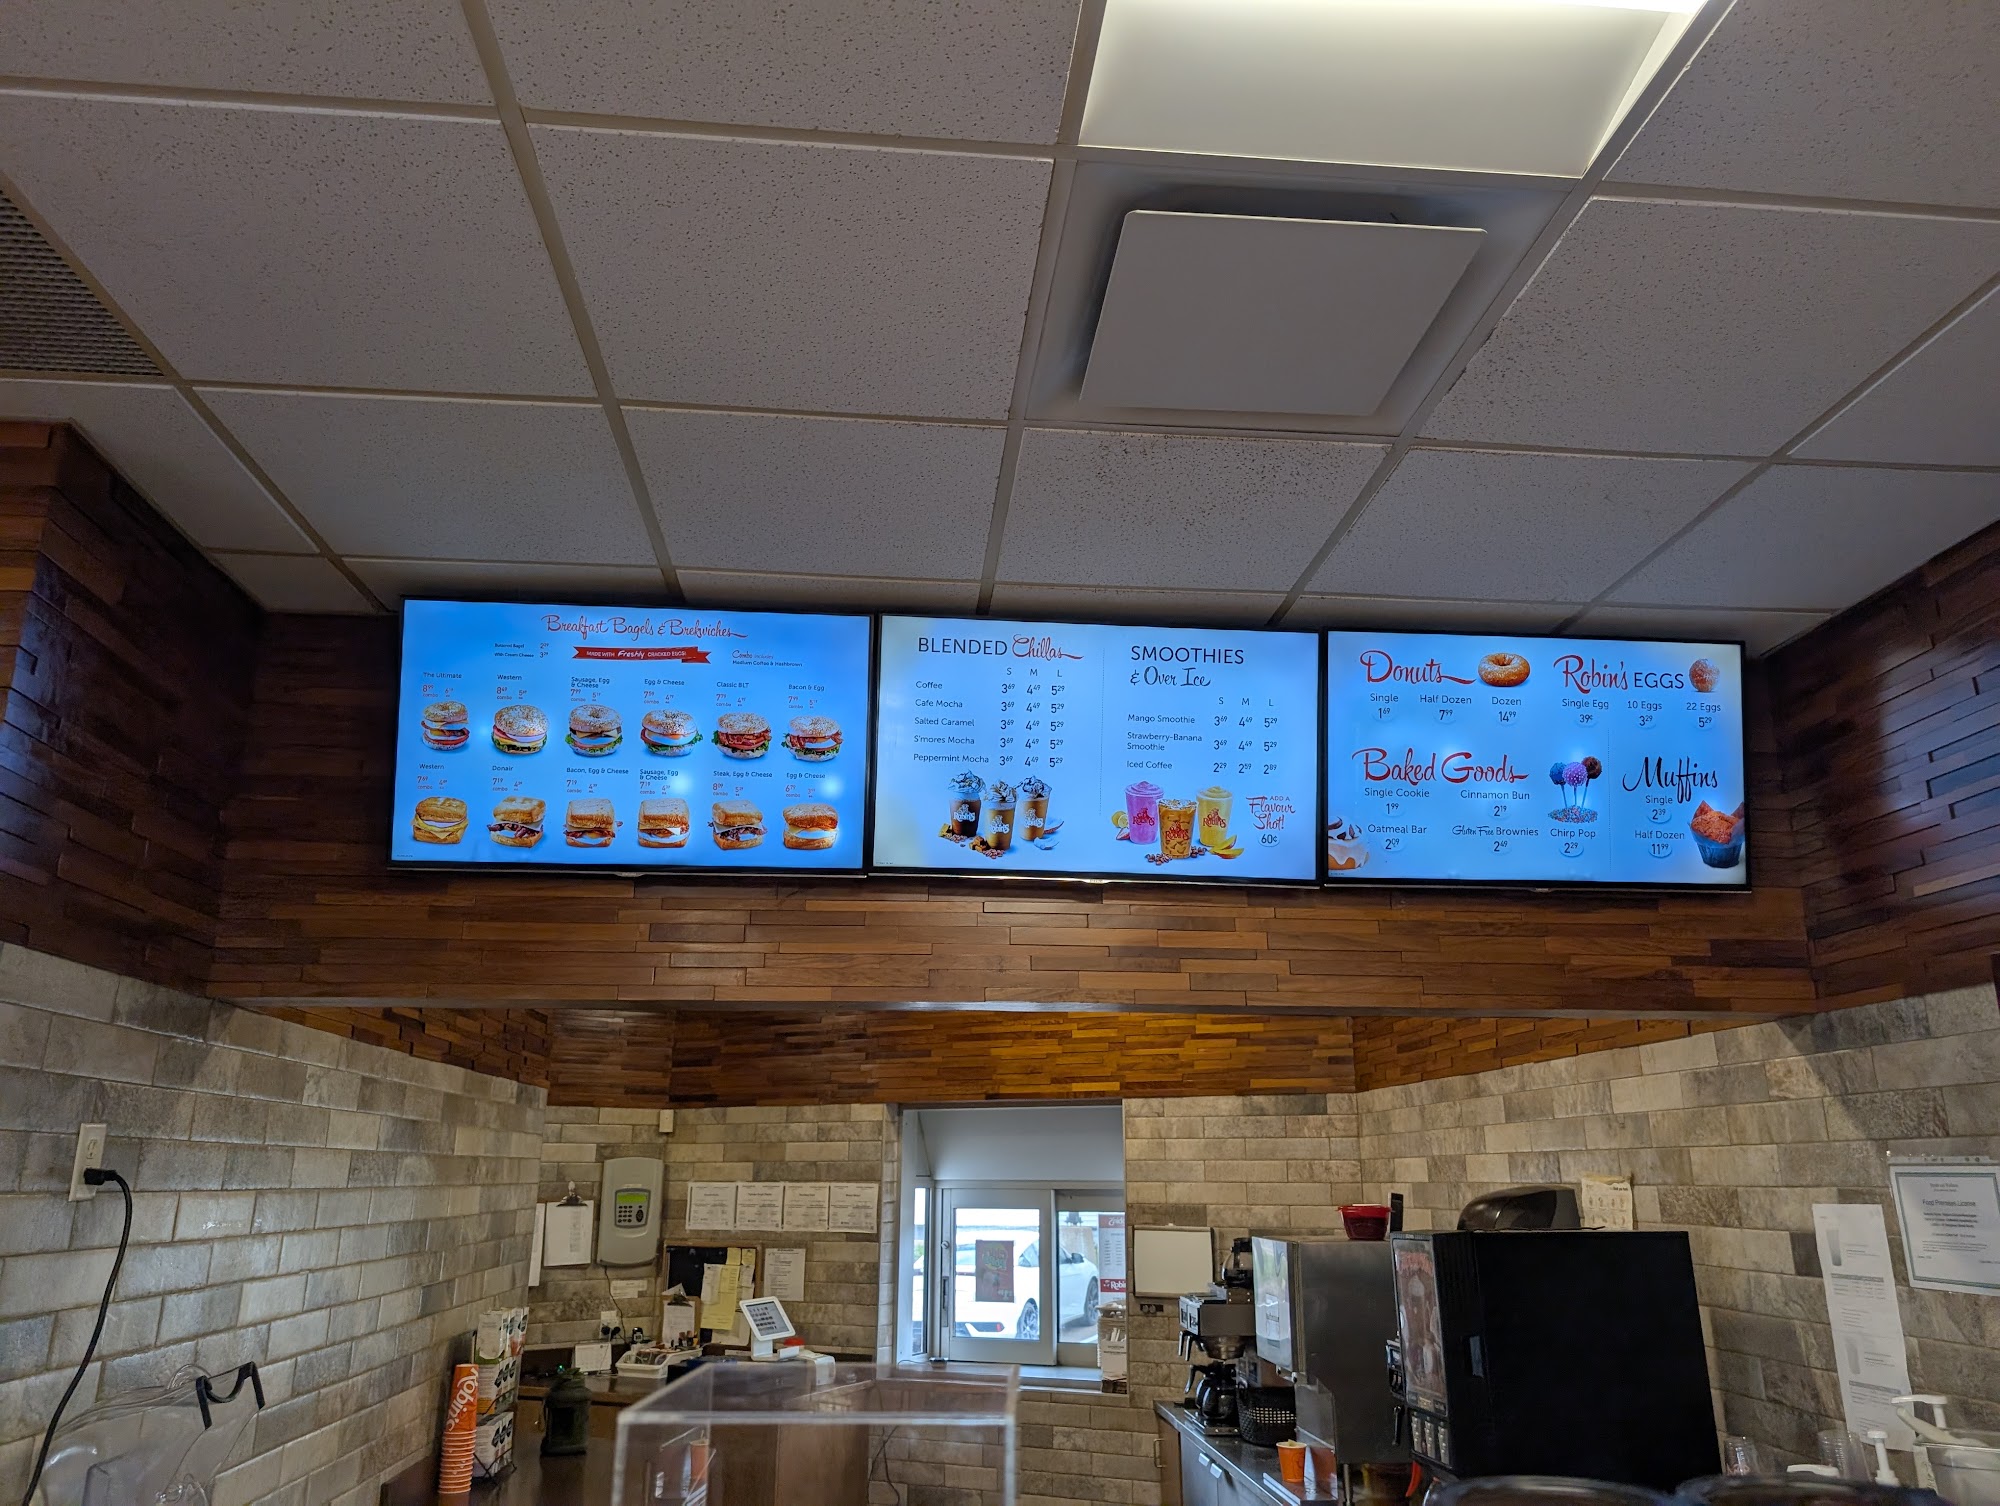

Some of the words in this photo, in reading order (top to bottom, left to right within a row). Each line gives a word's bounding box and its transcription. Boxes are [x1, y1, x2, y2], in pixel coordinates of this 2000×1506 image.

[541, 614, 607, 641] Breakfast
[607, 616, 654, 641] Bagels
[664, 618, 748, 638] Brekwiches
[919, 637, 1007, 655] BLENDED
[1012, 634, 1084, 661] Chillas
[617, 650, 645, 659] Freshly
[1131, 646, 1243, 664] SMOOTHIES
[1007, 667, 1012, 675] S
[1359, 649, 1477, 685] Donuts
[1130, 669, 1140, 685] &
[1144, 666, 1177, 686] Over
[1180, 667, 1211, 686] Ice
[1553, 654, 1628, 694] Robin's
[1634, 672, 1684, 689] EGGS
[916, 681, 942, 689] Coffee
[1370, 693, 1398, 704] Single
[1420, 695, 1439, 703] Half
[1442, 695, 1471, 704] Dozen
[1492, 697, 1521, 705] Dozen
[1562, 698, 1589, 709] Single
[1593, 699, 1609, 710] Egg
[1628, 701, 1638, 709] 10
[1641, 701, 1662, 711] Eggs
[1686, 702, 1697, 710] 22
[1700, 703, 1721, 713] Eggs
[915, 717, 939, 725] Salted
[941, 718, 974, 726] Caramel
[1128, 714, 1155, 723] Mango
[1158, 715, 1195, 723] Smoothie
[1580, 714, 1593, 723] 39¢
[914, 735, 945, 743] S'mores
[948, 736, 974, 744] Mocha
[1128, 732, 1202, 743] Strawberry-Banana
[1127, 742, 1165, 751] Smoothie
[914, 754, 959, 762] Peppermint
[962, 755, 989, 763] Mocha
[1146, 761, 1172, 769] Coffee
[1351, 747, 1437, 786] Baked
[1440, 751, 1530, 784] Goods
[1622, 756, 1718, 804] Muffins
[1365, 788, 1393, 798] Single
[1396, 788, 1429, 797] Cookie
[1460, 790, 1508, 799] Cinnamon
[1512, 791, 1529, 799] Bun
[1246, 795, 1296, 814] Flavour
[1645, 795, 1673, 806] Single
[1253, 810, 1285, 831] Shot!
[1368, 824, 1408, 834] Oatmeal
[1412, 825, 1427, 833] Bar
[1476, 825, 1495, 837] Free
[1495, 827, 1539, 837] Brownies
[1550, 828, 1575, 839] Chirp
[1579, 829, 1596, 839] Pop
[1261, 834, 1278, 844] 60¢
[1635, 830, 1653, 839] Half
[1656, 831, 1684, 839] Dozen
